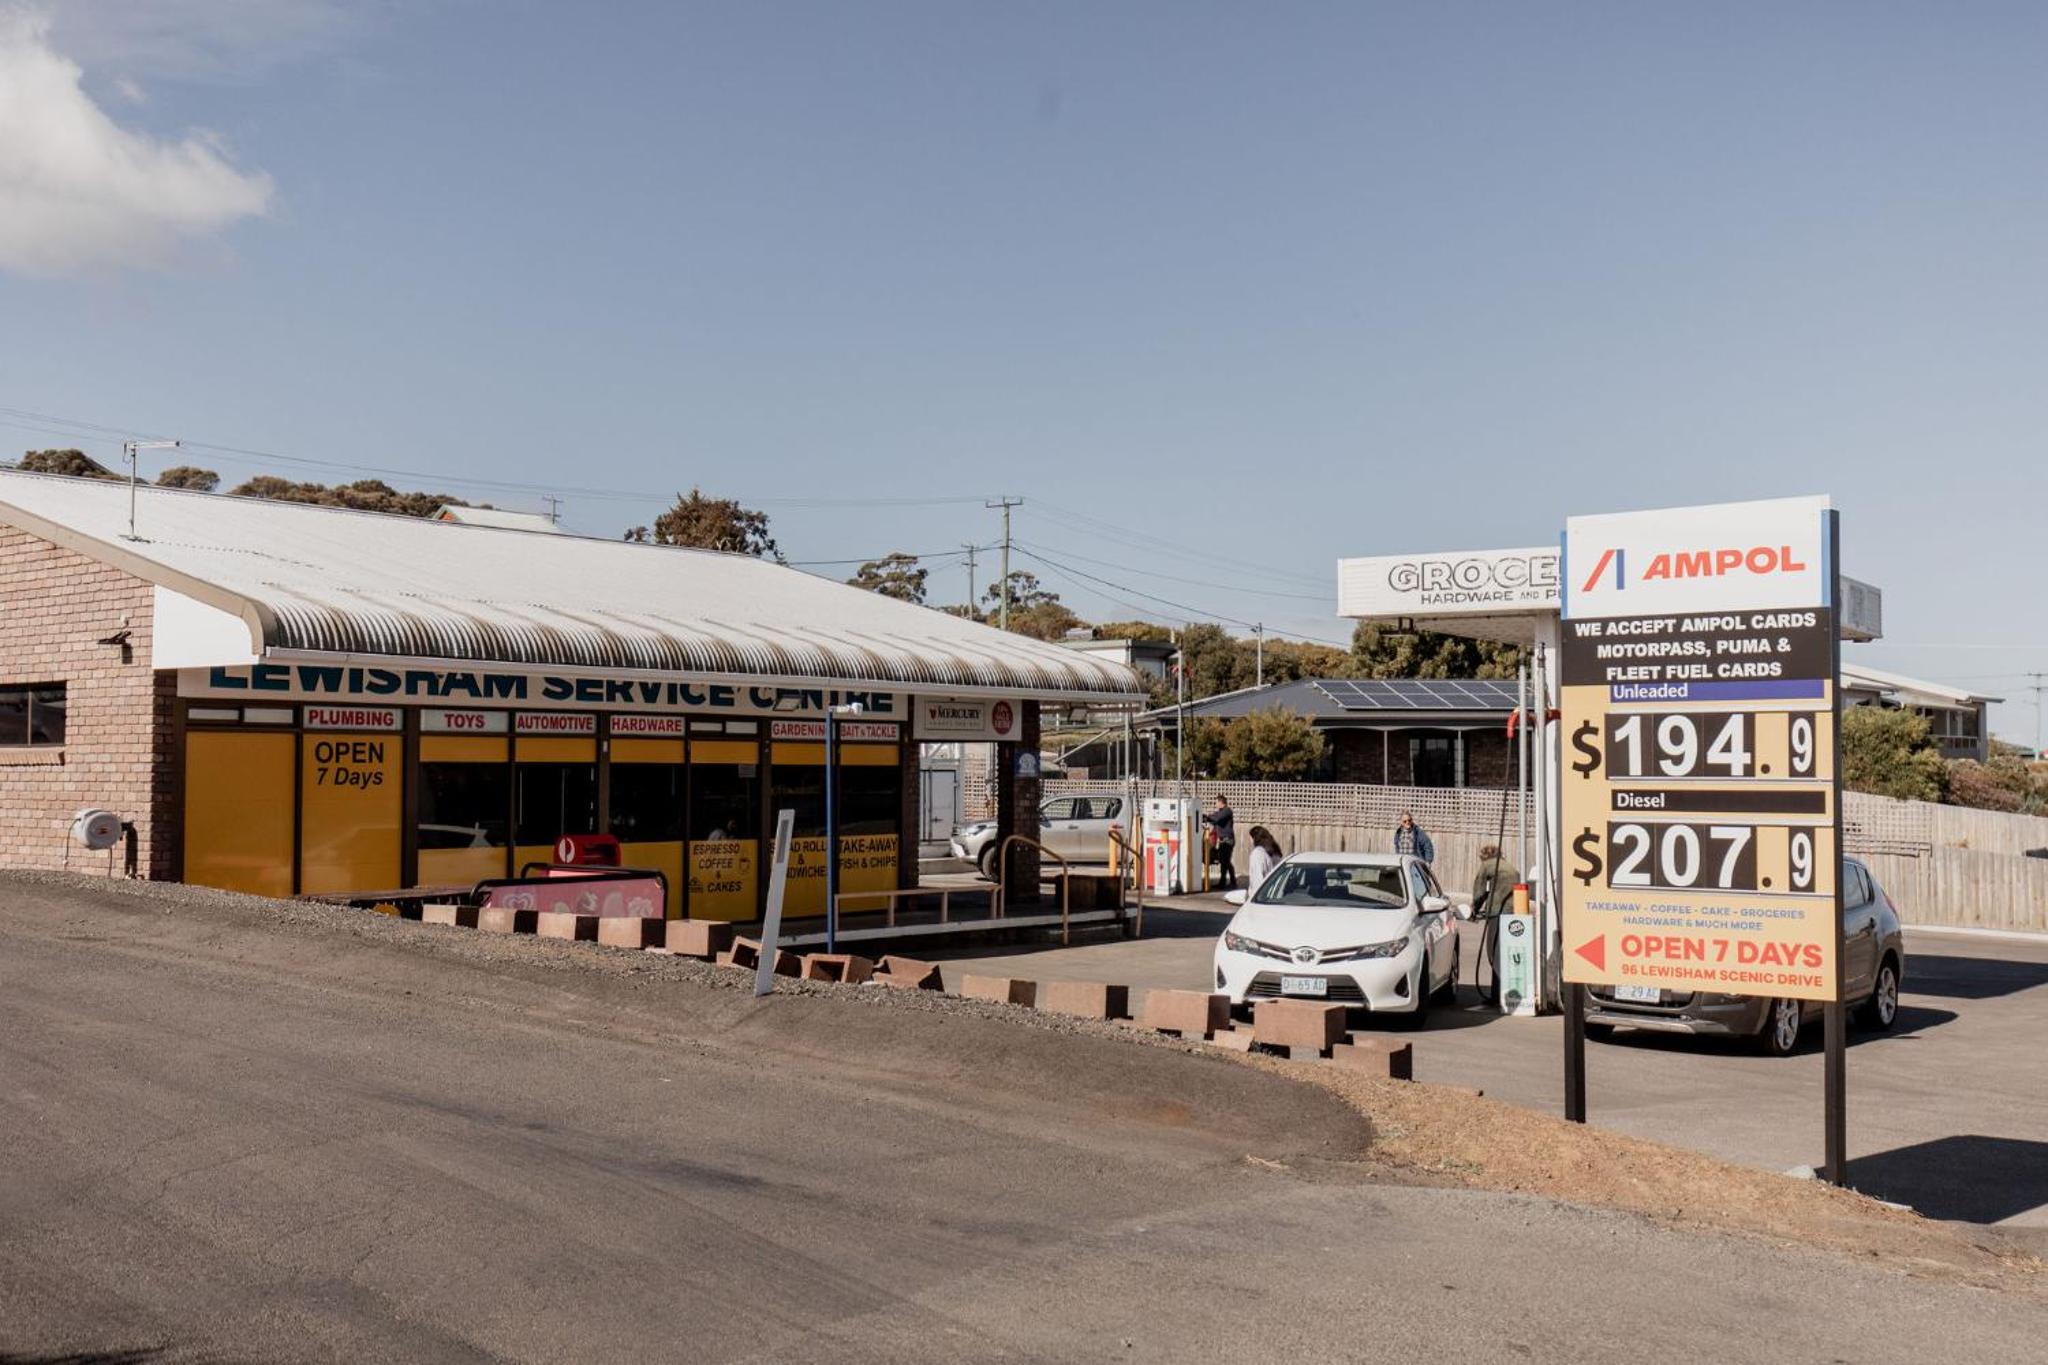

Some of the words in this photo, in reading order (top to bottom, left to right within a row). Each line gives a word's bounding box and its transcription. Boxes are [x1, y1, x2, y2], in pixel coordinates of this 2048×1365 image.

[1643, 546, 1806, 580] AMPOL
[1388, 556, 1562, 592] GROCE
[1421, 590, 1513, 604] HARDWARE
[1520, 591, 1539, 599] AND
[1575, 622, 1602, 637] WE
[1606, 619, 1676, 636] ACCEPT
[1682, 616, 1747, 632] AMPOL
[1752, 612, 1817, 629] CARDS
[1597, 641, 1712, 659] MOTORPASS,
[1717, 639, 1771, 654] PUMA
[1778, 637, 1791, 652] &
[1606, 666, 1661, 681] FLEET
[1666, 664, 1712, 679] FUEL
[1718, 662, 1782, 677] CARDS
[210, 664, 528, 699] LEWISHAM
[542, 676, 735, 706] SERVICE
[1613, 683, 1688, 699] Unleaded
[308, 709, 394, 726] PLUMBING
[444, 713, 485, 729] TOYS
[517, 715, 593, 730] AUTOMOTIVE
[611, 717, 682, 732] HARDWARE
[773, 723, 826, 736] GARDENIN
[841, 724, 859, 737] BAIT
[867, 725, 896, 738] TACKLE
[314, 742, 384, 763] OPEN
[317, 768, 329, 785] 7
[334, 768, 384, 789] Days
[1617, 793, 1665, 808] Diesel
[693, 843, 740, 855] ESPRESSO
[803, 839, 826, 851] ROLL
[838, 838, 897, 853] TAKE-AWAY
[699, 858, 733, 869] COFFEE
[870, 856, 897, 868] CHIPS
[707, 881, 742, 893] CAKES
[1585, 902, 1641, 912] TAKEAWAY
[1651, 904, 1692, 915] COFFEE
[1702, 906, 1731, 916] CAKE
[1740, 908, 1805, 919] GROCERIES
[1623, 917, 1683, 928] HARDWARE
[1695, 919, 1728, 930] MUCH
[1731, 920, 1764, 931] MORE
[1621, 935, 1705, 961] OPEN
[1712, 940, 1729, 962] 7
[1738, 941, 1823, 968] DAYS
[1641, 966, 1716, 980] LEWISHAM
[1720, 971, 1773, 983] SCENIC
[1778, 975, 1823, 987] DRIVE
